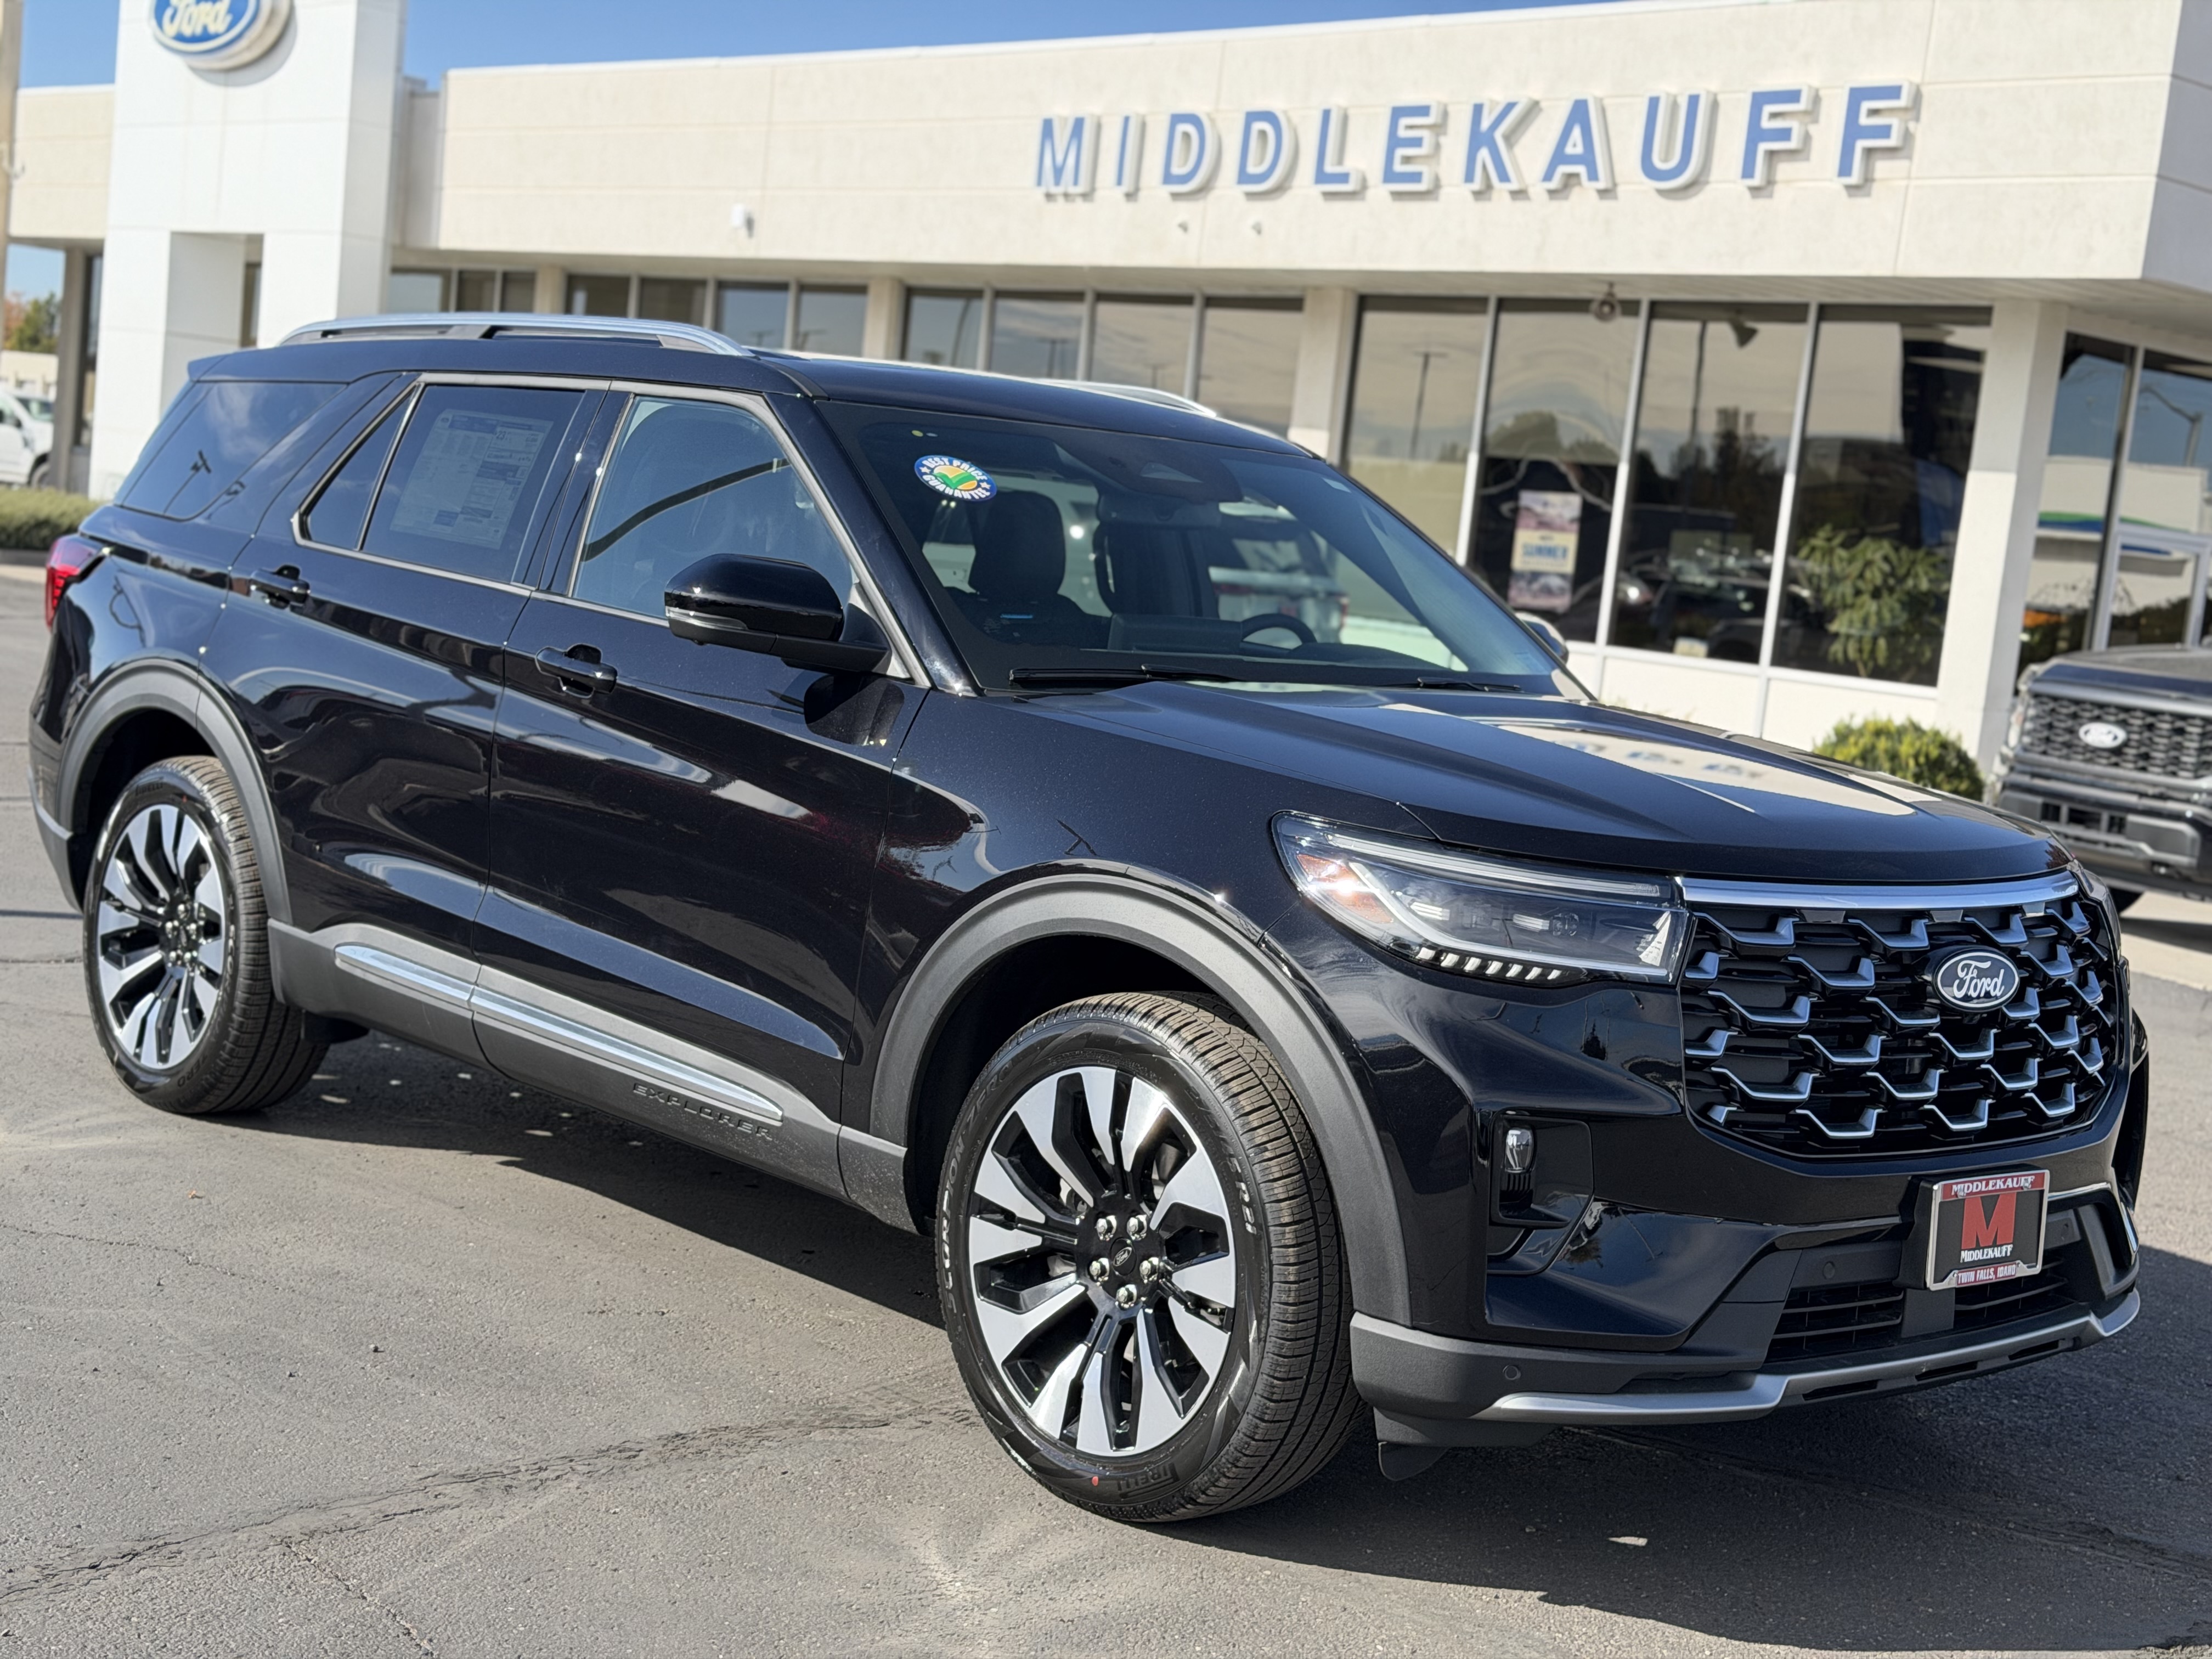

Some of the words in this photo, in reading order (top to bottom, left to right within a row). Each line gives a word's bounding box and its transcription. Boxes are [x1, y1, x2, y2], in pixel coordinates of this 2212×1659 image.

[162, 0, 233, 37] Ford
[1035, 81, 1919, 195] MIDDLEKAUFF
[922, 457, 950, 469] BEST
[952, 460, 988, 481] PRICE
[922, 475, 991, 500] GUARANTEE
[1954, 960, 2005, 998] Ford
[633, 1082, 773, 1141] EXPLORER
[941, 1135, 966, 1314] SCORPION
[1961, 1192, 2017, 1249] M
[1960, 1244, 2013, 1263] MIDDLEKAUFF
[1958, 1271, 1974, 1284] TWIN
[1976, 1267, 1996, 1281] FALLS,
[1997, 1264, 2017, 1278] IDAHO
[1116, 1462, 1181, 1499] PIRELLI
